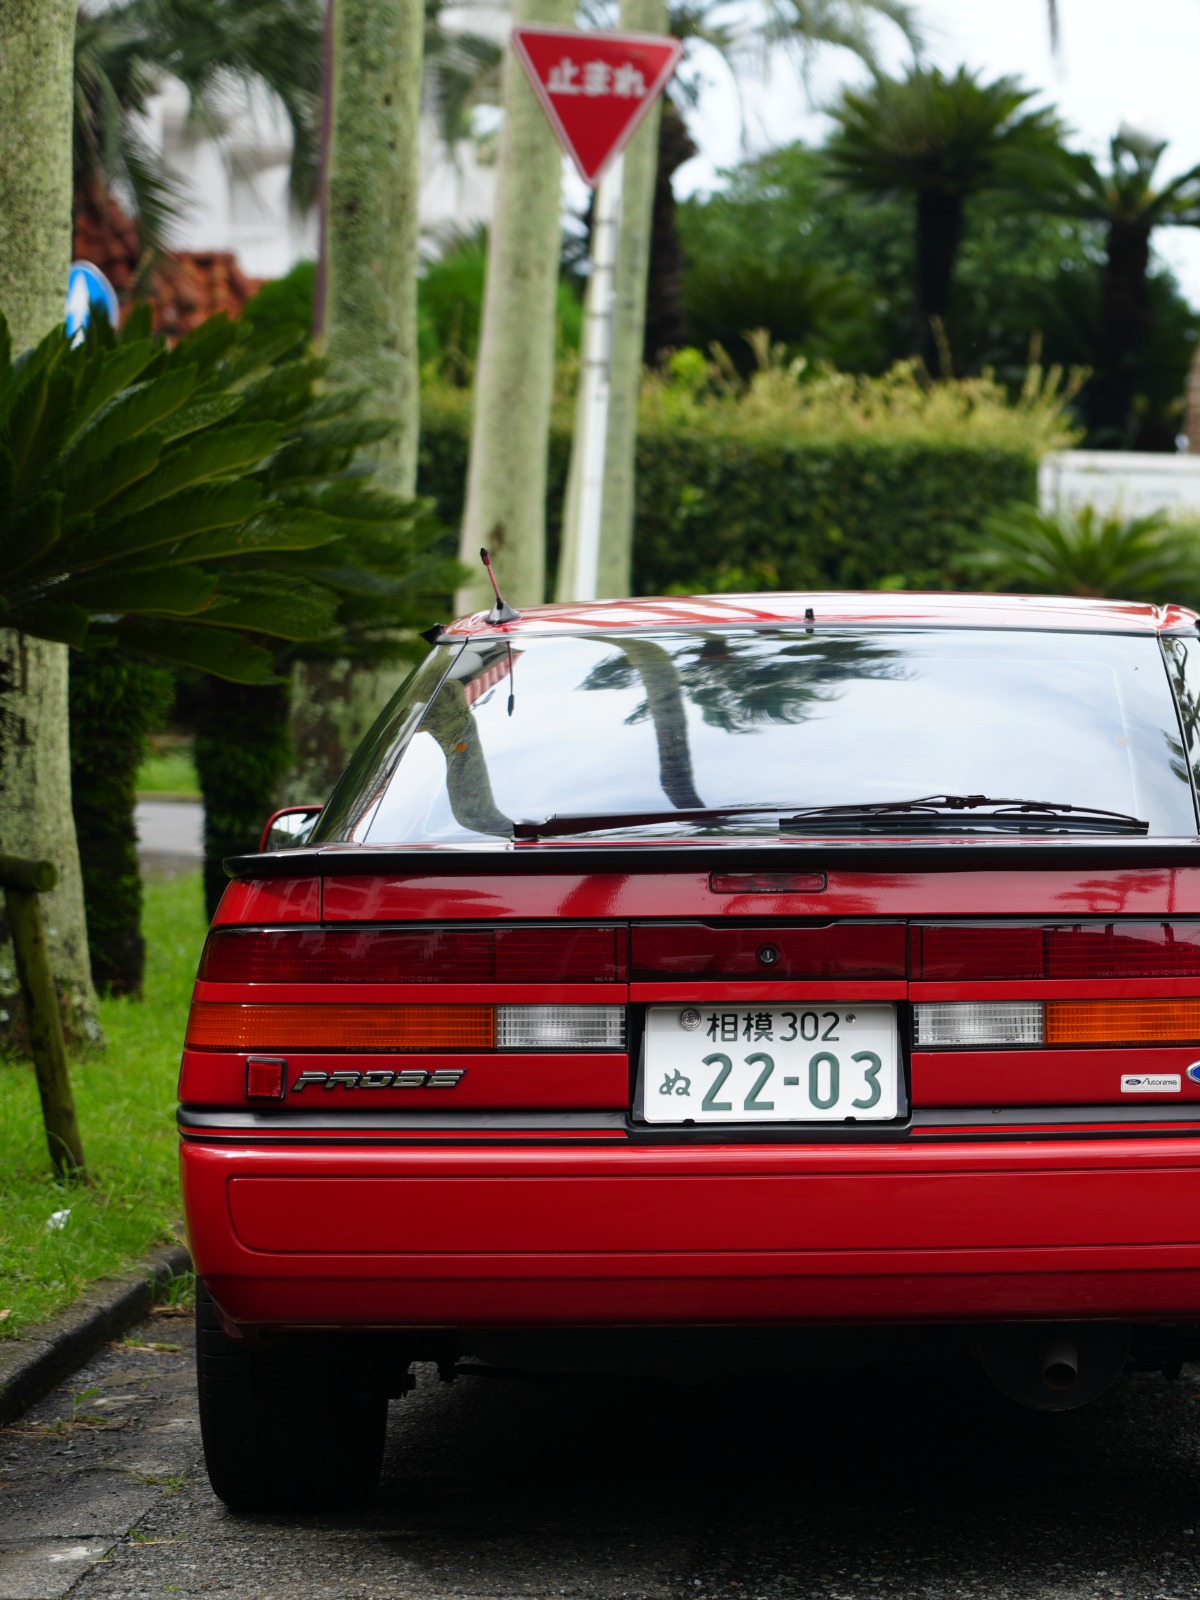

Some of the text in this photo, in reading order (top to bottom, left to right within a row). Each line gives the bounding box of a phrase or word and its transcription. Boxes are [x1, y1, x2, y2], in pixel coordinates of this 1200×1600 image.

[547, 57, 647, 98] 止まれ
[706, 1011, 840, 1043] 相模 302
[290, 1069, 467, 1093] PROBE
[659, 1050, 882, 1111] ぬ 22-03
[1141, 1077, 1178, 1086] Autorama
